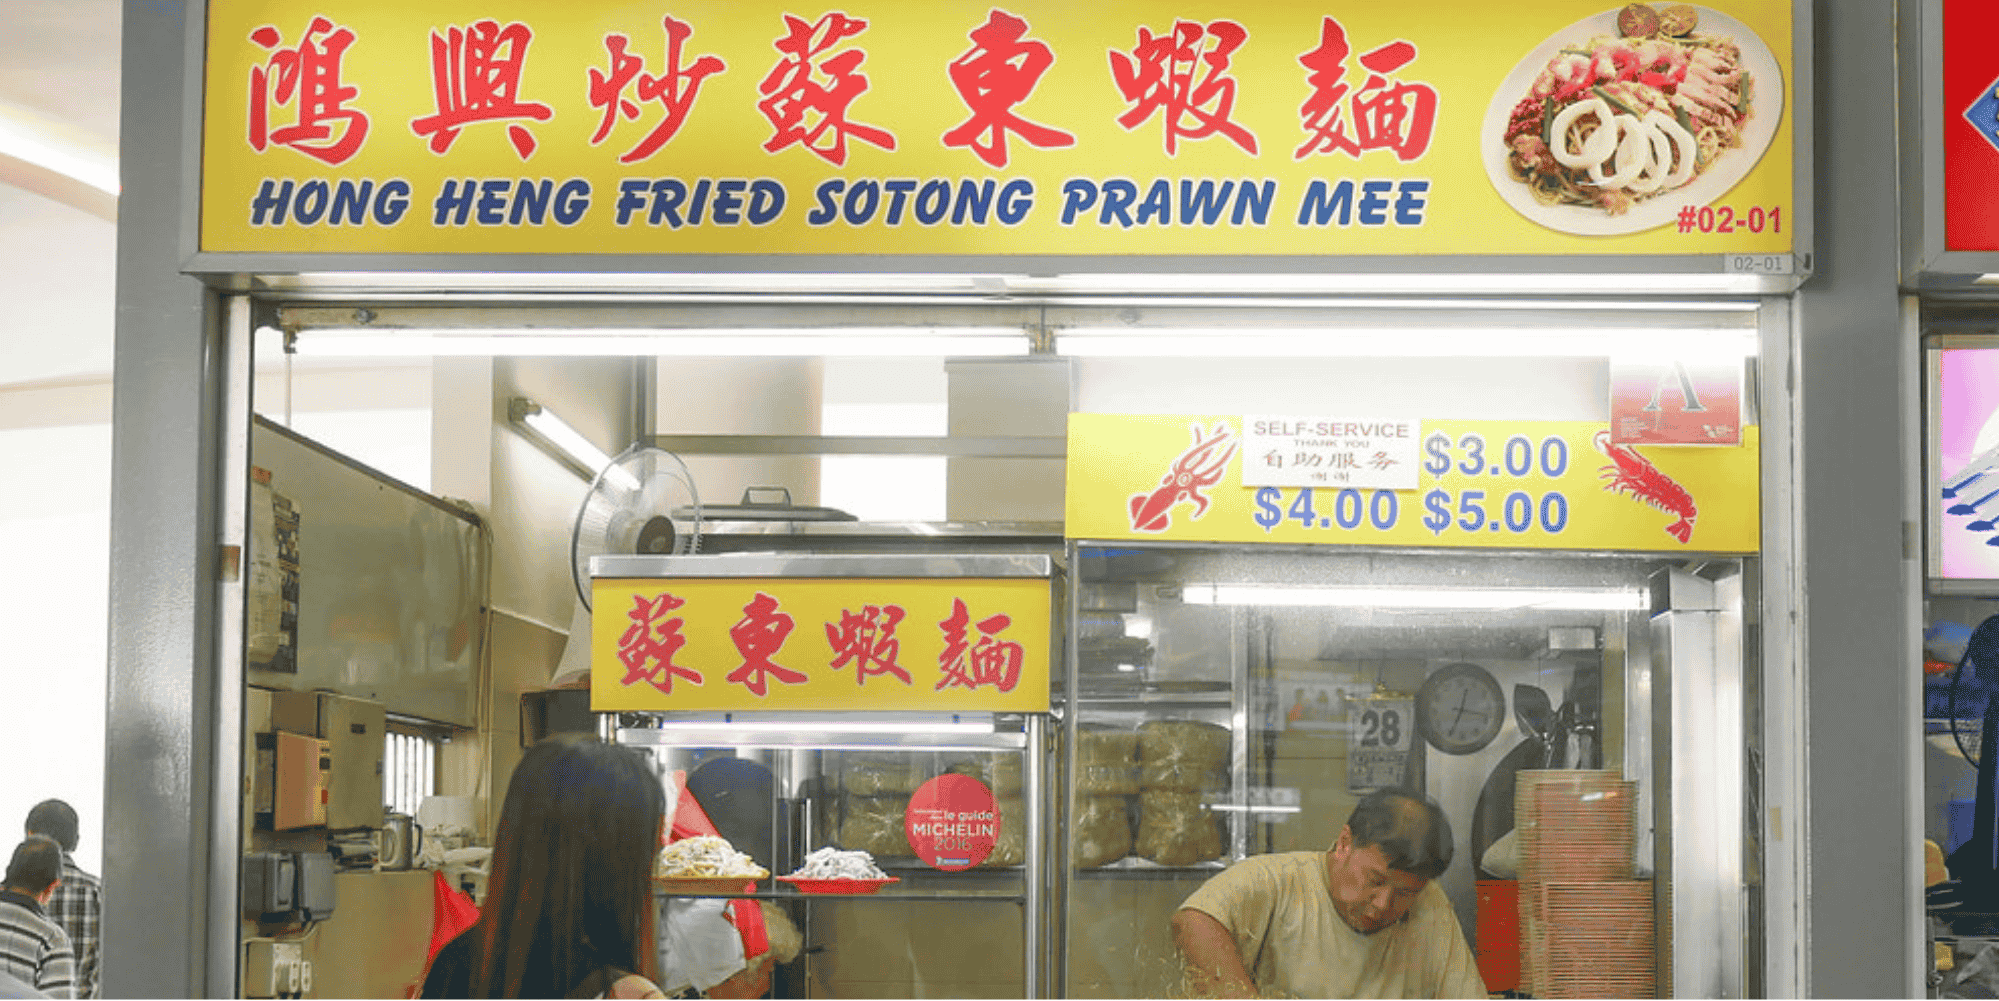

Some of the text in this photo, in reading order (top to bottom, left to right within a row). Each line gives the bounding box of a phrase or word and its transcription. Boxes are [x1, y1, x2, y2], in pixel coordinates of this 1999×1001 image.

[250, 179, 1429, 229] HONG HENG FRIED SOTONG PRAWN MEE
[1677, 205, 1782, 233] #02-01
[1734, 256, 1783, 270] 02-01
[1254, 421, 1410, 438] SELF-SERVICE
[1423, 434, 1569, 479] $3.00
[1253, 486, 1568, 535] $4.00 $5.00
[1361, 709, 1401, 748] 28
[912, 822, 994, 837] MICHELIN
[934, 836, 973, 852] 2016
